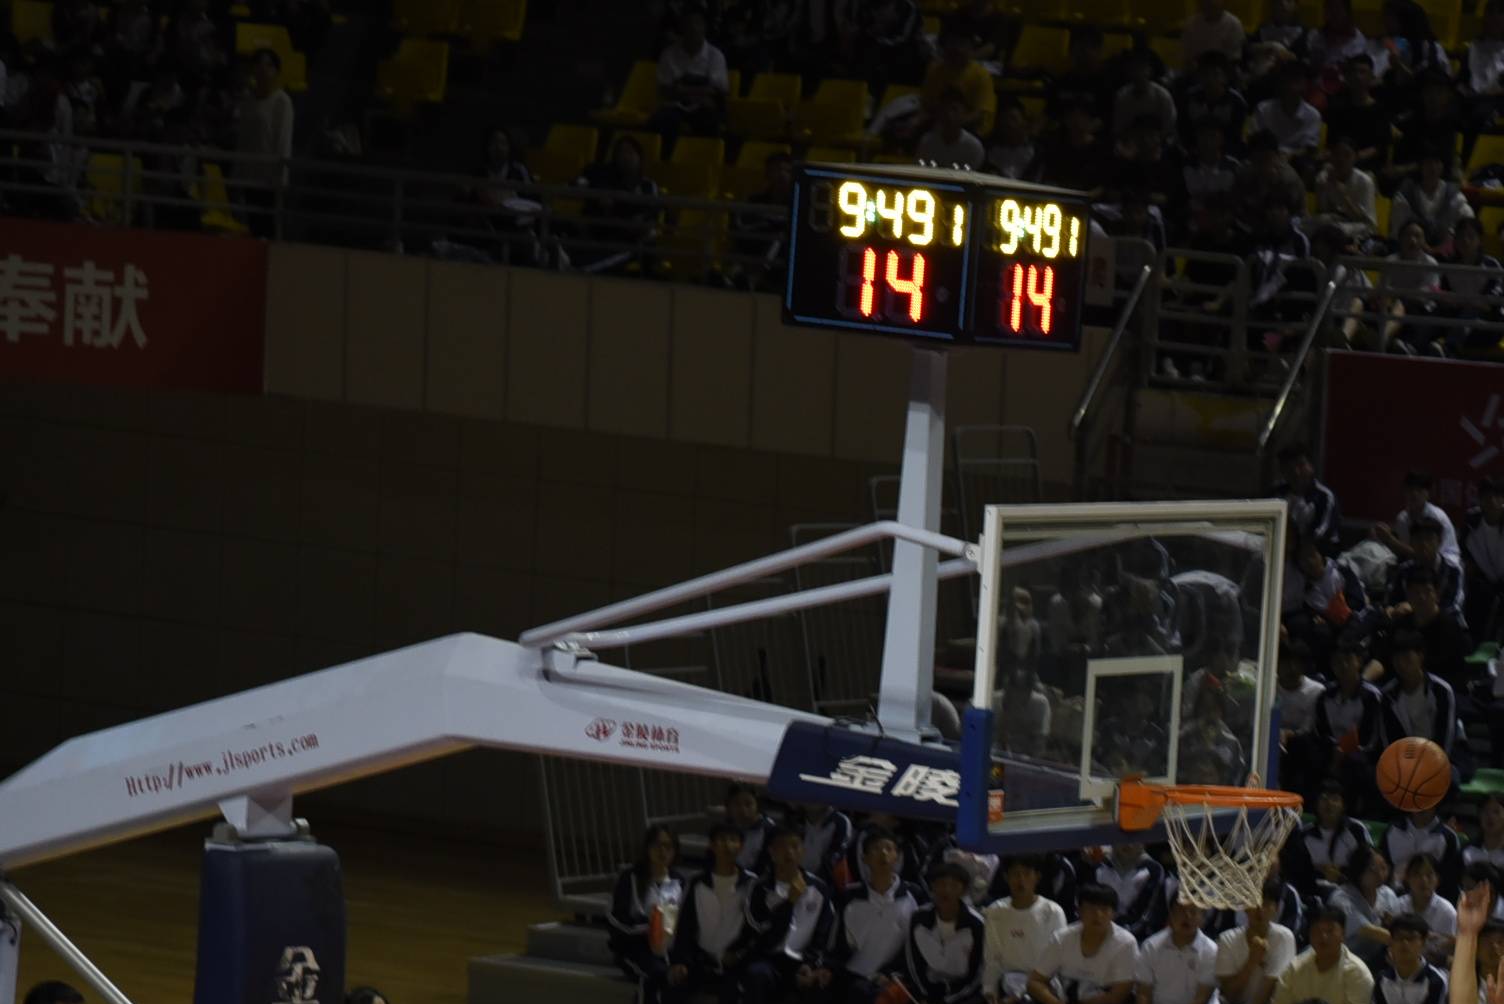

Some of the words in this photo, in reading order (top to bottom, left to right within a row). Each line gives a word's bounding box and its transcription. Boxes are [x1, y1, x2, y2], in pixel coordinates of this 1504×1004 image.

[0, 254, 149, 350] 奉献
[857, 246, 928, 324] 14
[1008, 262, 1055, 336] 14
[797, 754, 960, 808] 金陵
